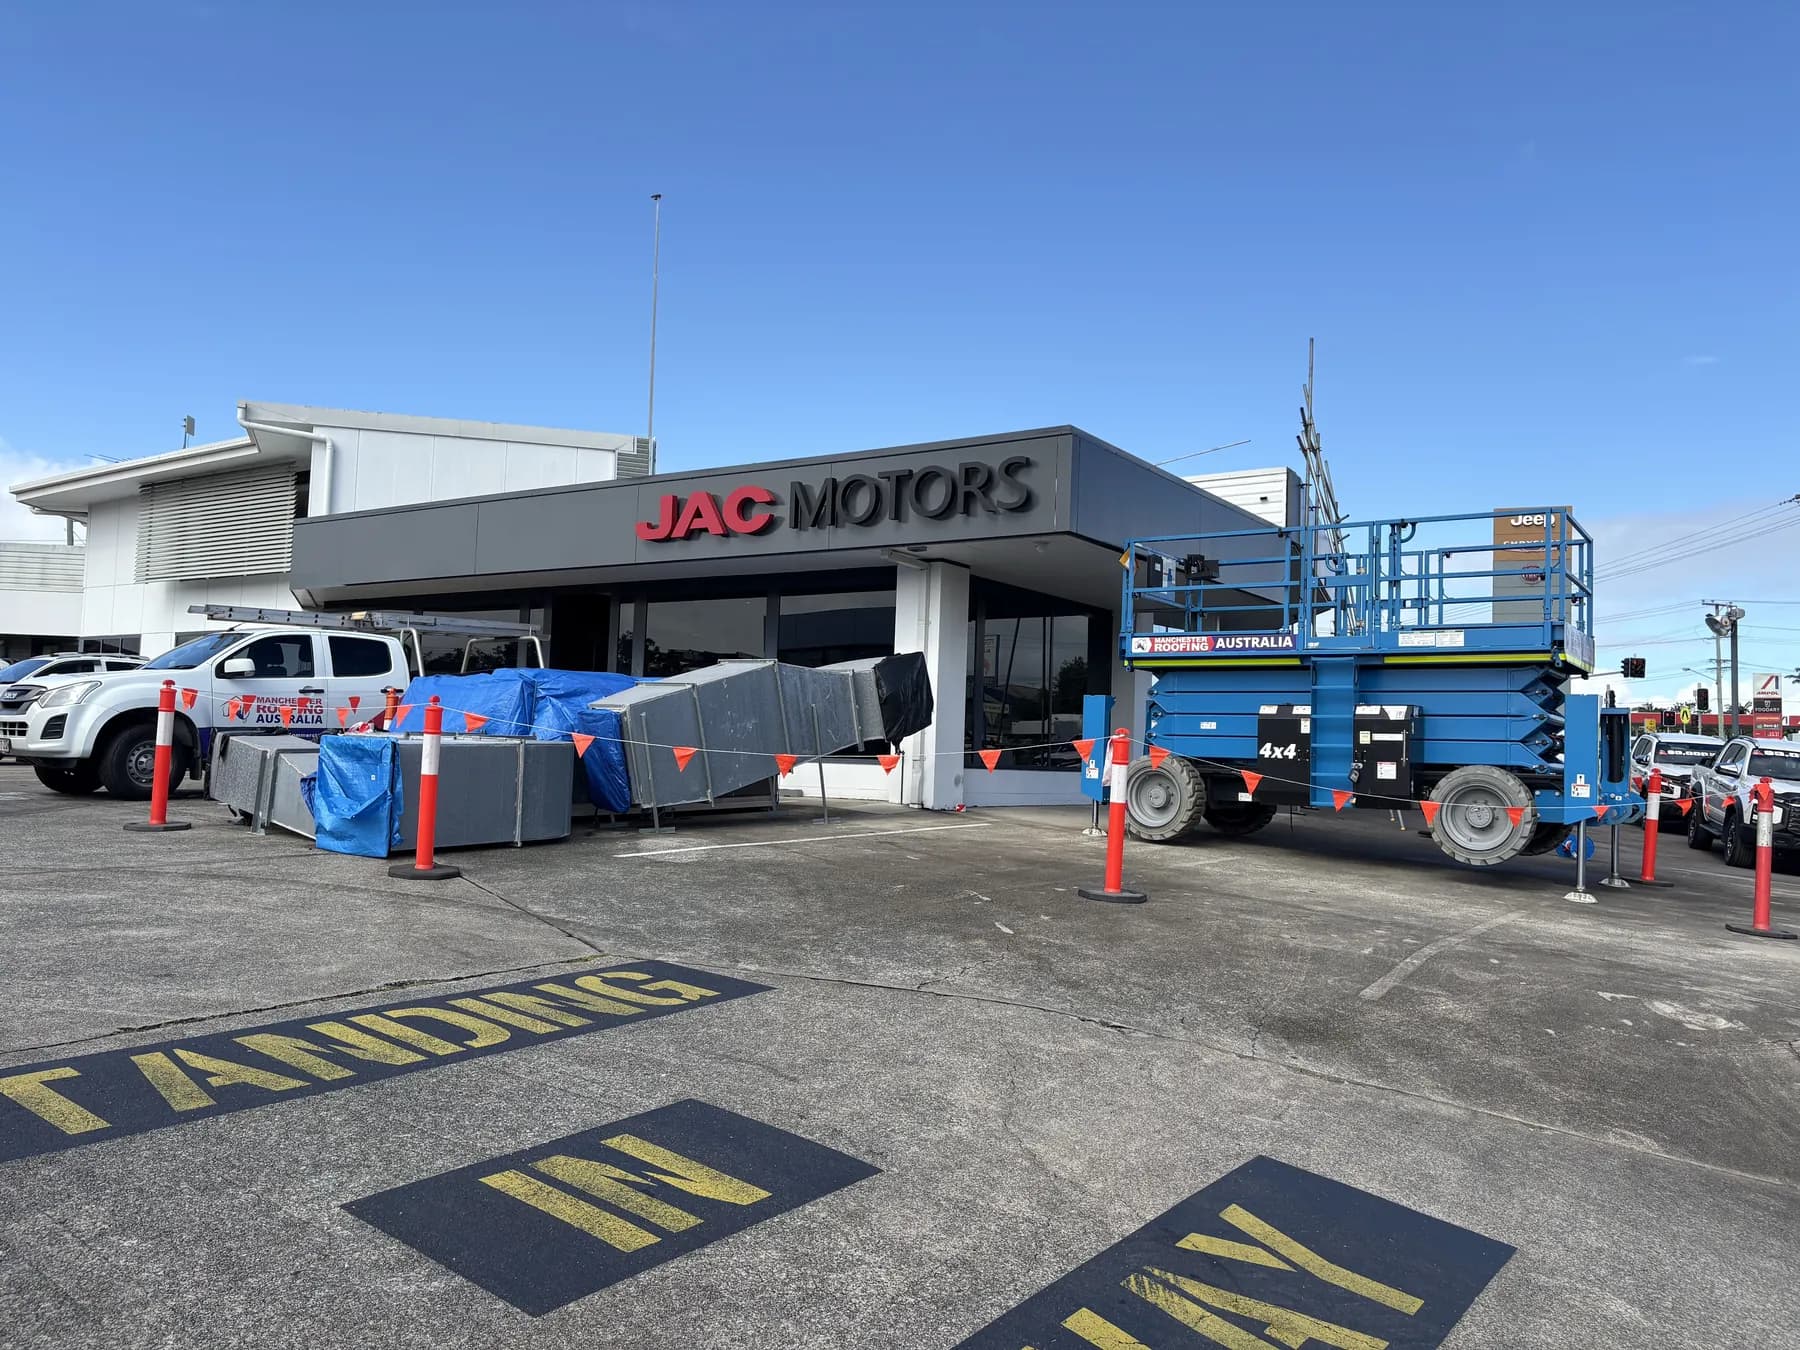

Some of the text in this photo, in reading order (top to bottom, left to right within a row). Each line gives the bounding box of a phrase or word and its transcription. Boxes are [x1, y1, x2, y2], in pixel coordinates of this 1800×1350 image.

[635, 456, 1032, 542] JAC MOTORS
[1511, 514, 1555, 527] Jeep
[1154, 643, 1209, 651] ROOFING
[1215, 636, 1293, 649] AUSTRALIA
[256, 697, 322, 705] MANCHEER
[256, 704, 323, 714] ROFING
[256, 714, 323, 724] AUSRALIA
[1259, 742, 1297, 760] 4x4
[480, 1133, 772, 1252] IN
